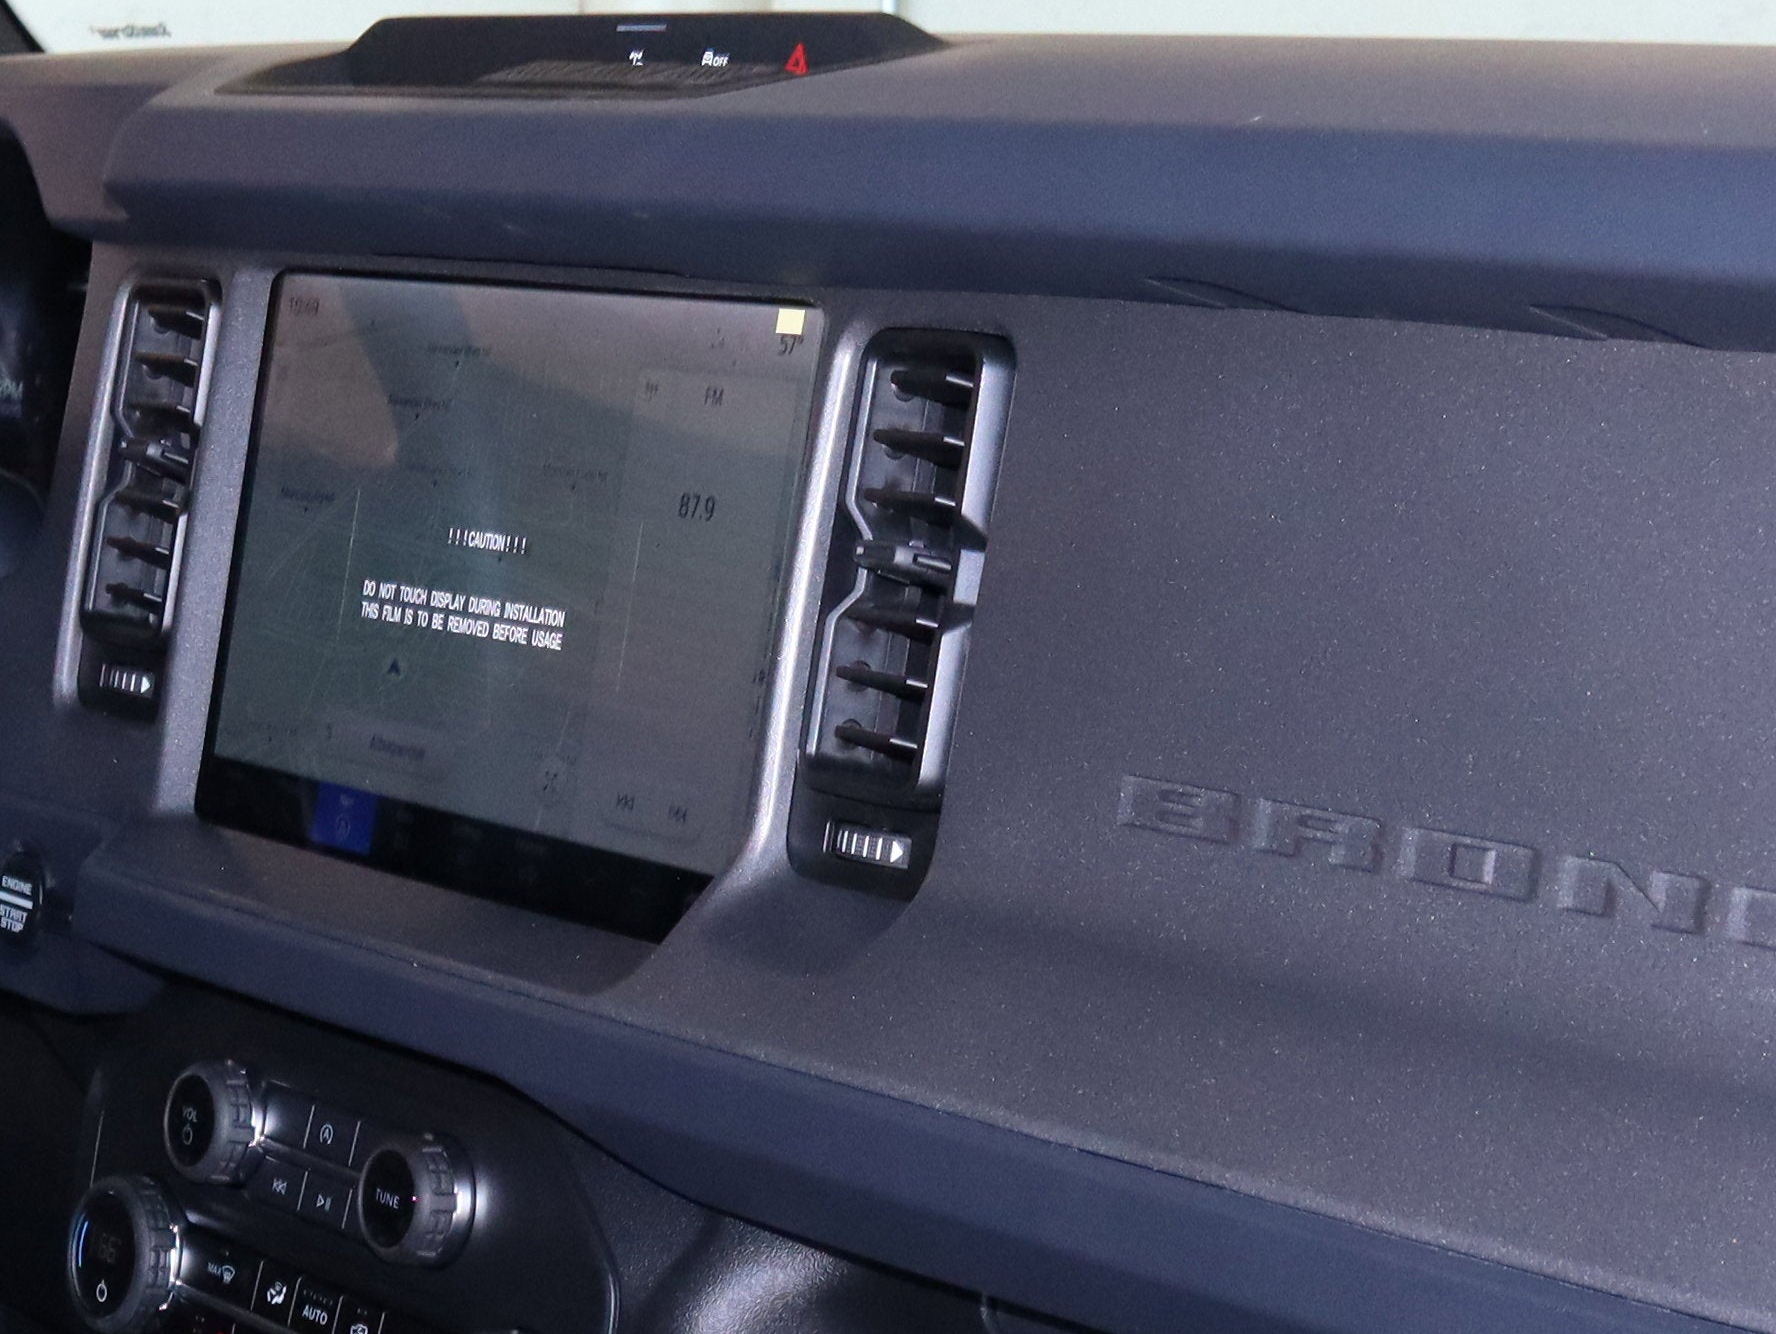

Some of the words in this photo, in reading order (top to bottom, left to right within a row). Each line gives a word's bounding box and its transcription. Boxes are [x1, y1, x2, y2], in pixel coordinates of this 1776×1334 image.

[704, 386, 724, 407] FM
[678, 492, 716, 522] 87.9
[363, 579, 376, 597] DO
[378, 582, 398, 599] NOT
[400, 585, 428, 605] TOUCH
[430, 590, 466, 612] DISPLAY
[468, 597, 501, 618] DURING
[504, 602, 566, 628] INSTALLATION
[361, 601, 379, 620] THIS
[382, 606, 402, 623] FILM
[404, 608, 413, 626] IS
[417, 610, 429, 627] TO
[431, 613, 444, 631] BE
[447, 616, 489, 638] REMOVED
[492, 623, 529, 645] BEFORE
[531, 629, 564, 651] USAGE
[1, 875, 32, 896] ENGINE
[0, 903, 28, 924] START
[0, 916, 24, 933] STOP
[182, 1106, 198, 1123] VOL
[374, 1187, 400, 1210] TUNE
[302, 1304, 328, 1326] AUTO
